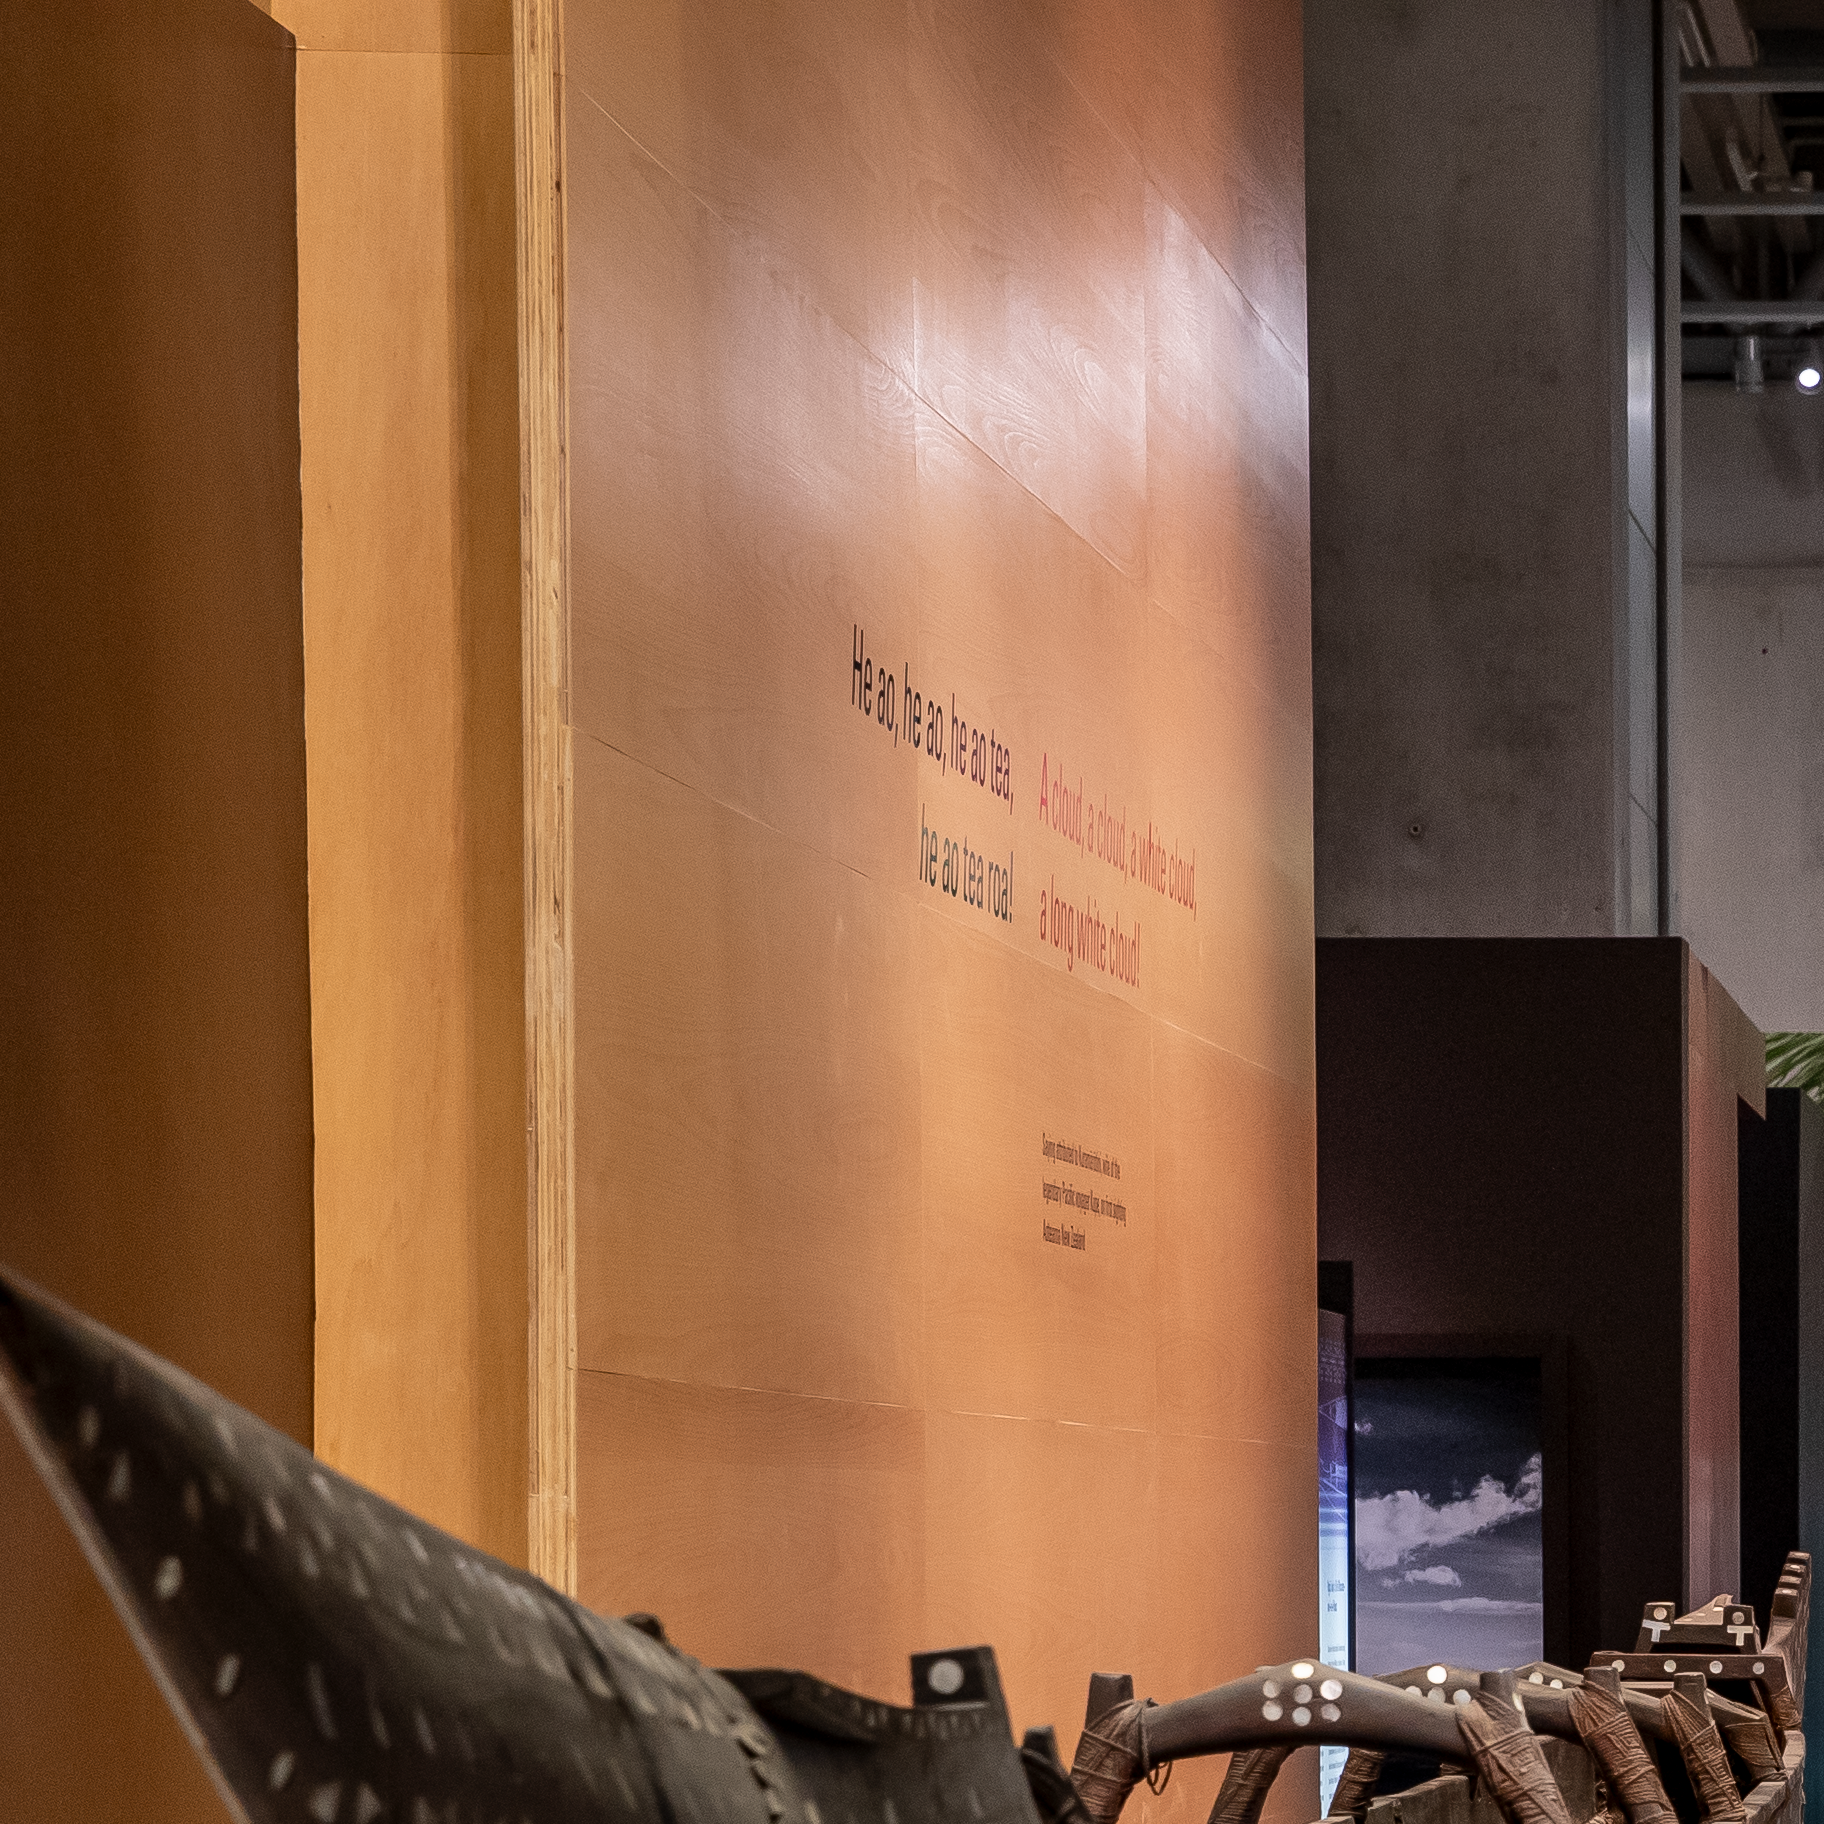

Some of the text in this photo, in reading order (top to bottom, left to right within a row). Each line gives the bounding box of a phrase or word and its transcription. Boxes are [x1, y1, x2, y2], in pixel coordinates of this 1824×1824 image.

[852, 624, 1014, 815] He ao, he ao, he ao tea,
[919, 802, 1014, 924] he ao tea roa!
[1039, 752, 1197, 922] A cloud, a cloud, a white cloud,
[1040, 873, 1141, 989] a long white cloud!
